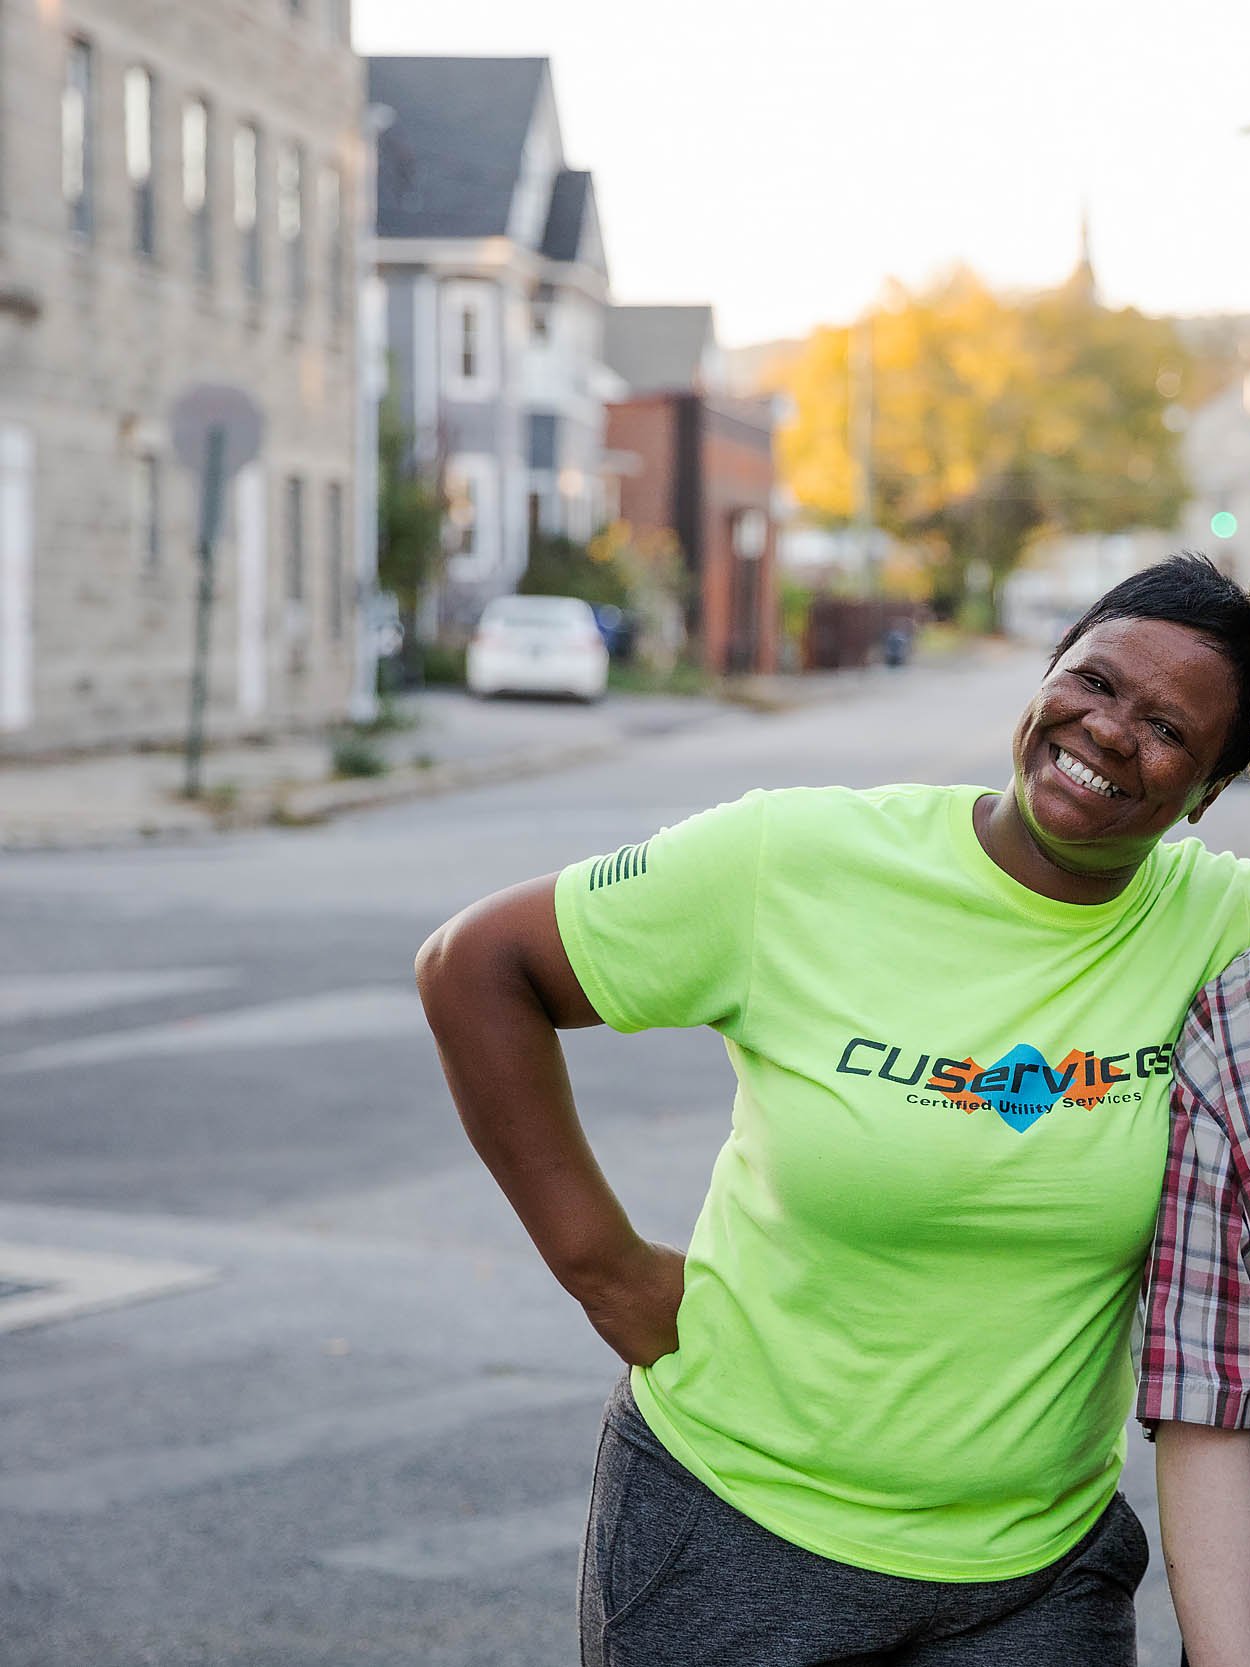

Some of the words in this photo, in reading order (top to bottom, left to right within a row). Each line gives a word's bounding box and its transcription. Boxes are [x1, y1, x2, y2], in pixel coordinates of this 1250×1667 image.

[906, 1094, 992, 1111] Certified
[999, 1100, 1054, 1115] Utility
[1062, 1092, 1142, 1108] Services
